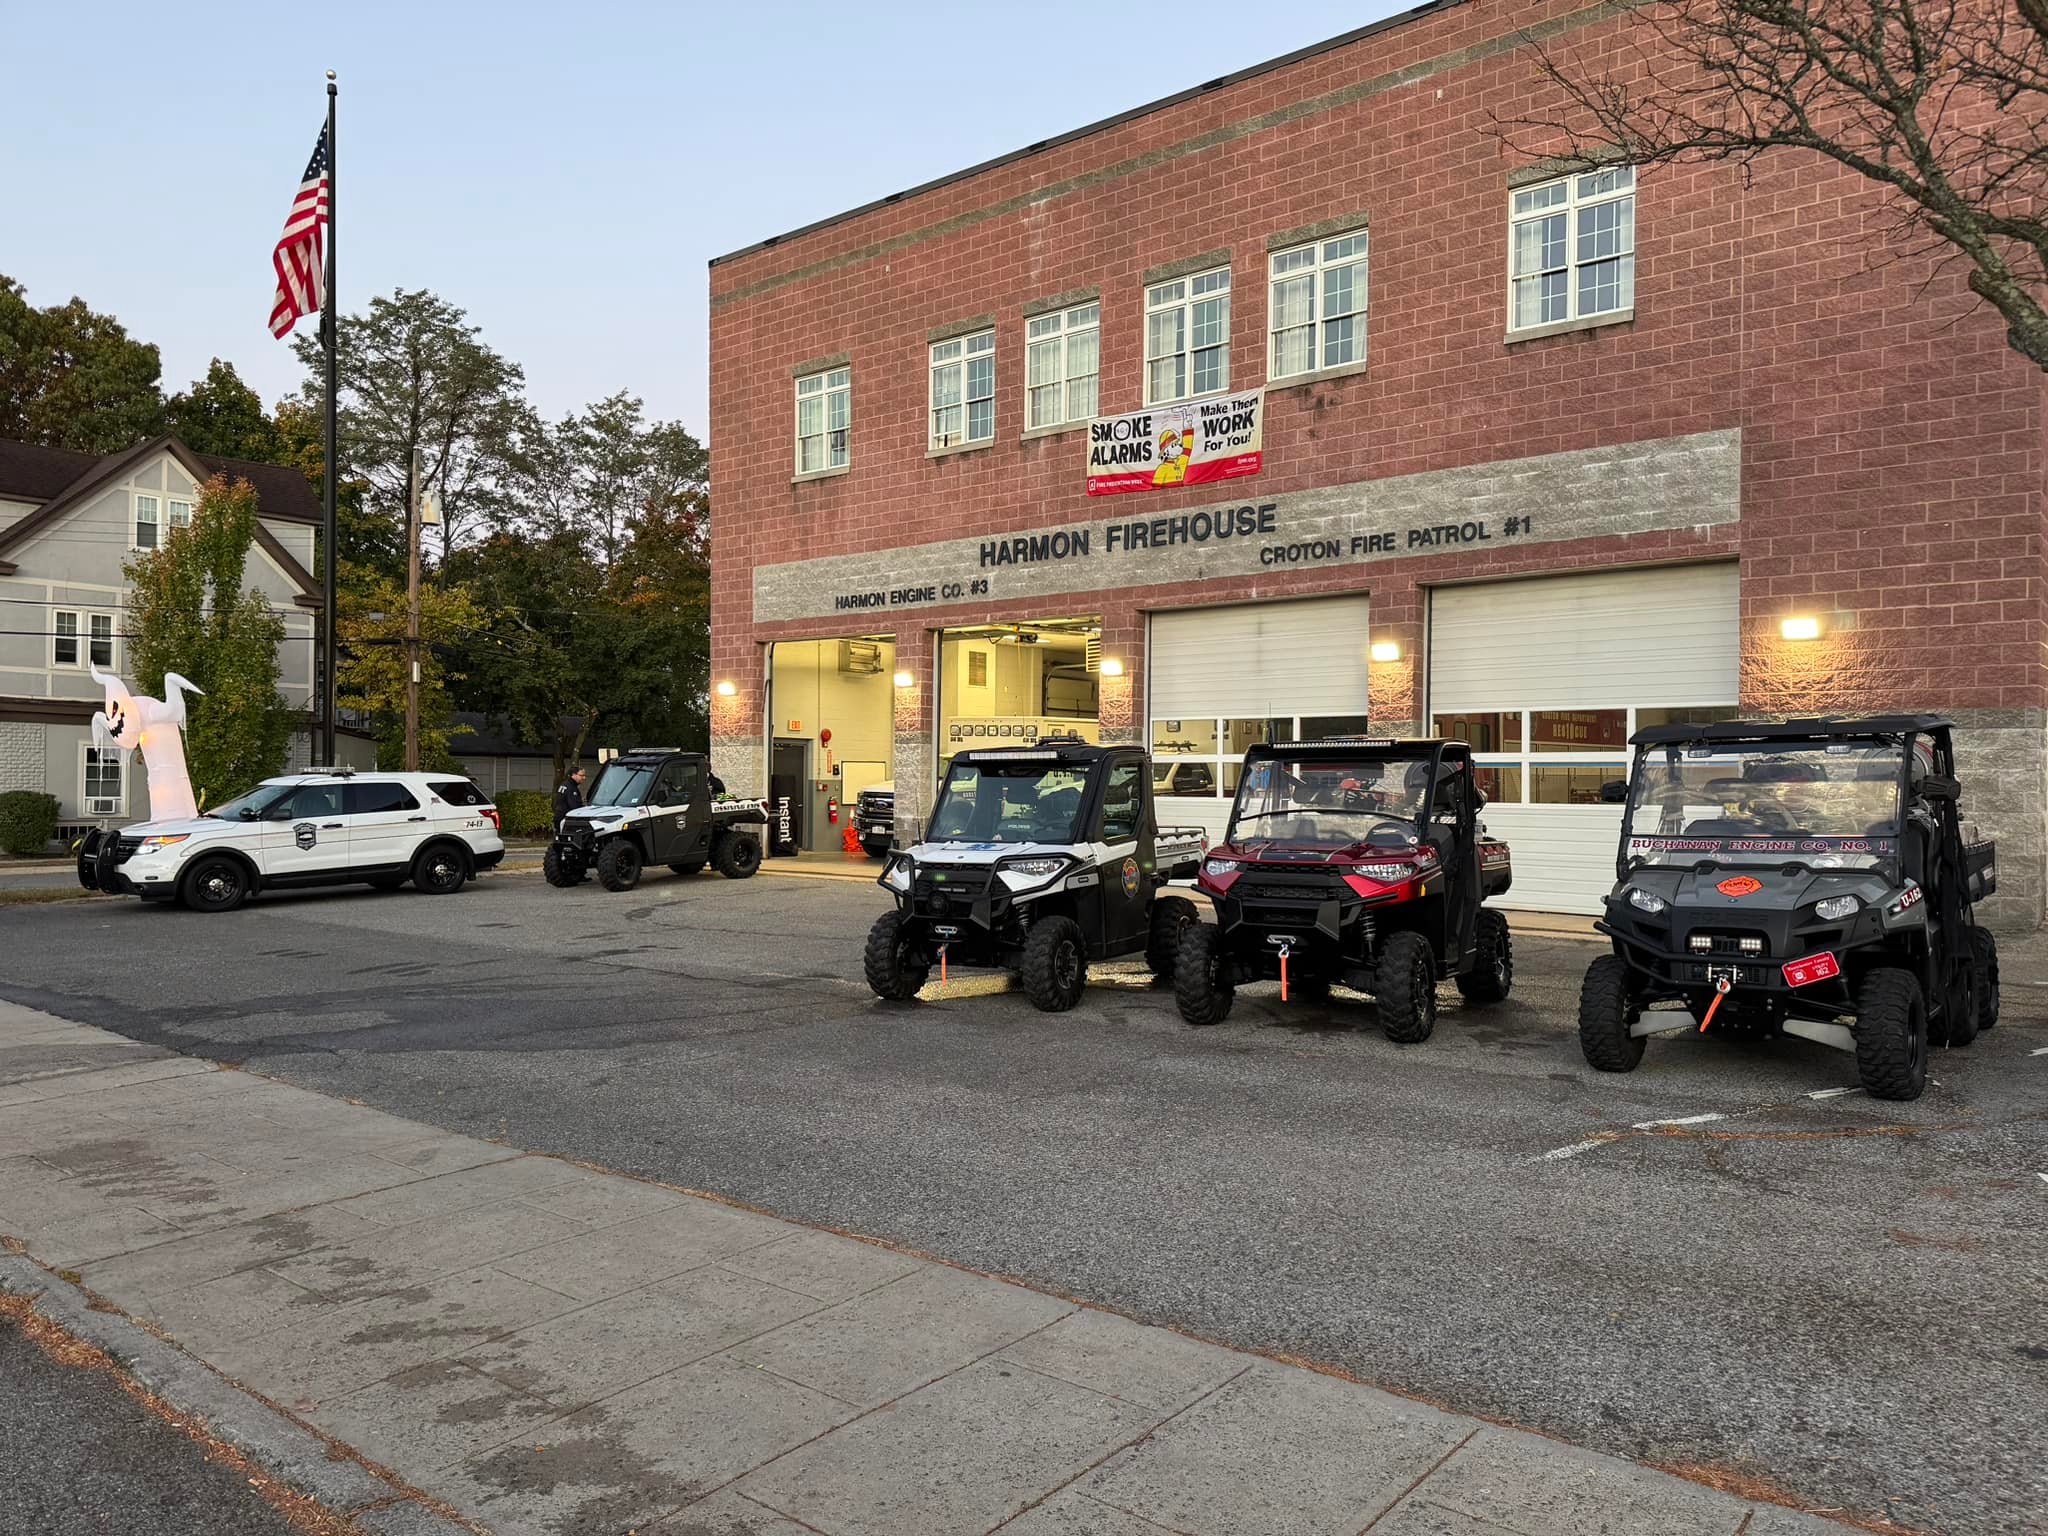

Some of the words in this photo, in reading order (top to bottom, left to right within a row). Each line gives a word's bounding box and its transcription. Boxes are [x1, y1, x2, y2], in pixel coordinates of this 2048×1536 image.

[1200, 404, 1228, 418] Make
[1231, 397, 1258, 412] Them
[1091, 415, 1152, 442] SMOKE
[1202, 409, 1255, 438] WORK
[1090, 441, 1152, 466] ALARMS
[1204, 439, 1223, 452] For
[1226, 432, 1251, 447] You!
[980, 530, 1089, 567] HARMON
[1106, 504, 1276, 553] FIREHOUSE
[1260, 540, 1340, 565] CROTON
[1351, 532, 1396, 554] FIRE
[1408, 521, 1491, 548] PATROL
[1504, 515, 1531, 537] #1
[835, 591, 885, 610] HARMON
[890, 586, 936, 605] ENGINE
[942, 582, 965, 599] CO.
[970, 580, 988, 595] #3
[778, 796, 792, 843] Instant
[1632, 839, 1721, 850] BUCHANAN
[1728, 840, 1795, 850] ENGINE
[1801, 840, 1831, 850] CO.
[1840, 841, 1871, 851] NO.
[1880, 841, 1888, 851] 1
[1901, 887, 1922, 907] U-162
